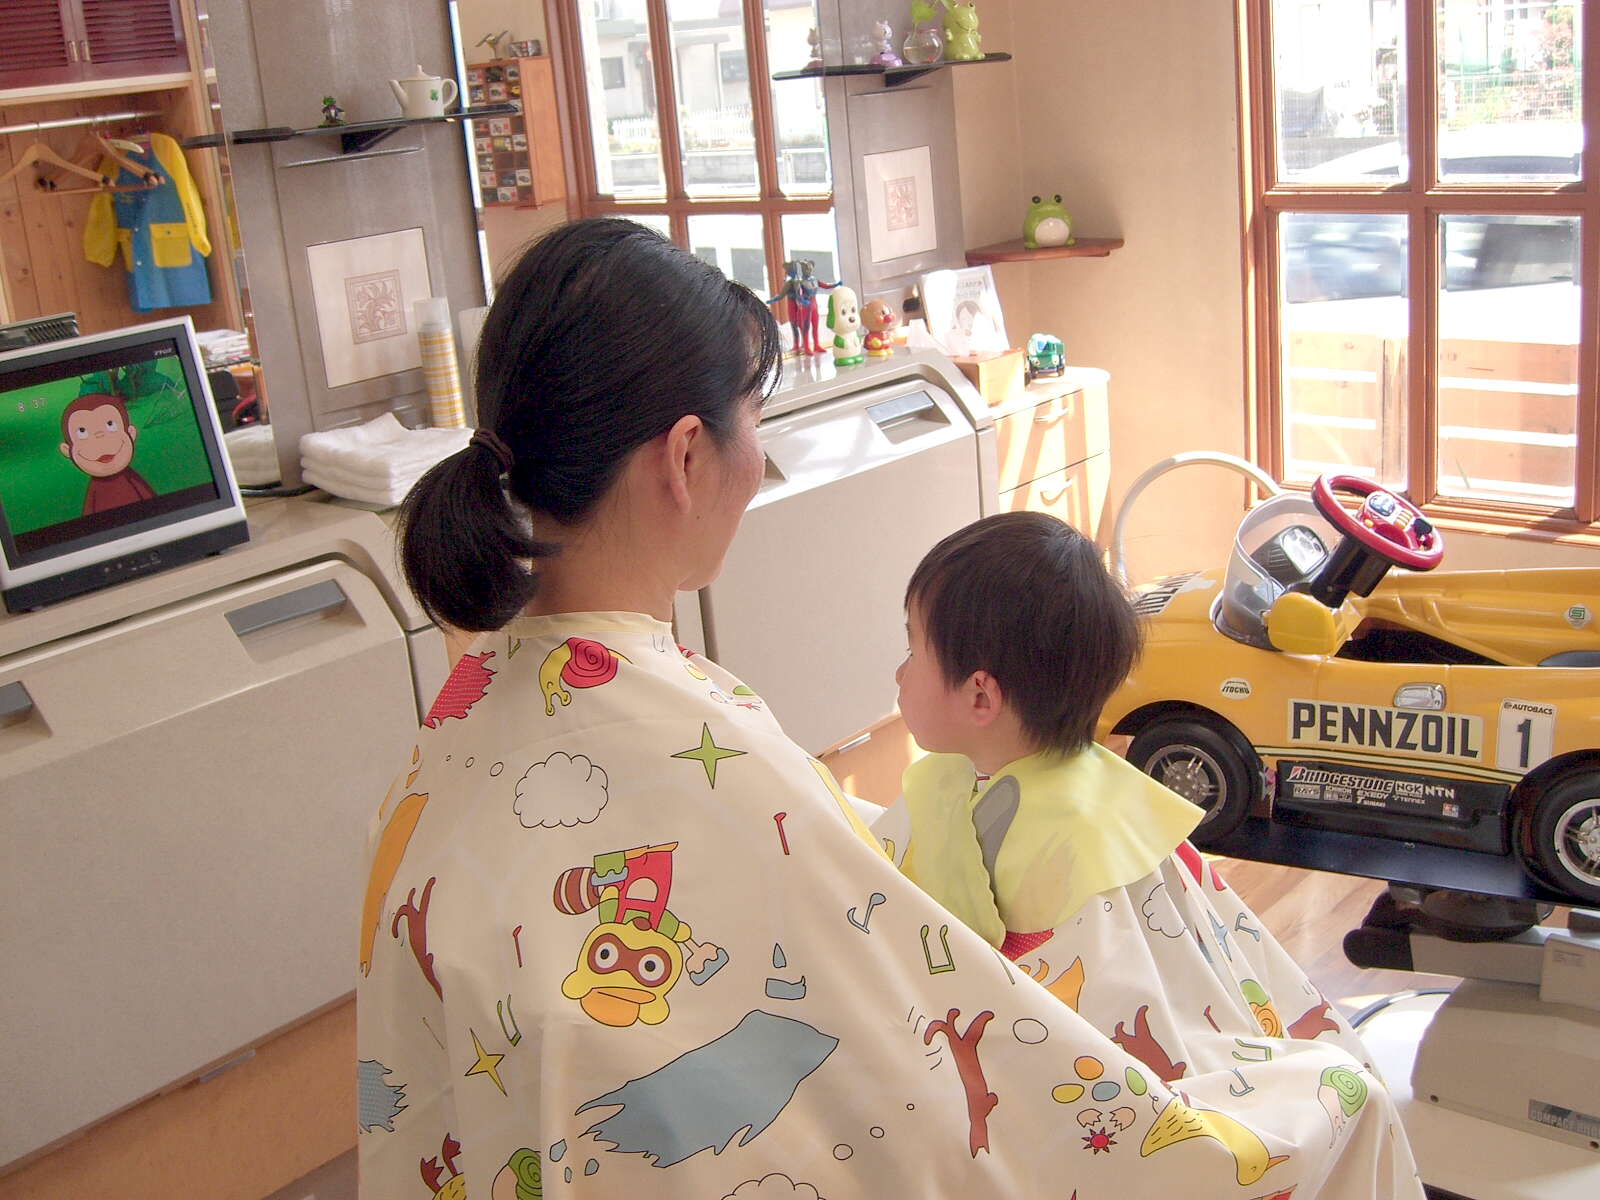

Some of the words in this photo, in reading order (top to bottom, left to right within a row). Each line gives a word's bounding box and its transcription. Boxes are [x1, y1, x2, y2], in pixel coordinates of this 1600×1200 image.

[1221, 685, 1250, 694] ITOCHU
[1511, 703, 1553, 715] AUTOBACS
[1292, 702, 1479, 759] PENNZOIL
[1517, 718, 1532, 769] 1
[1286, 766, 1395, 794] BRIDGESTONE
[1294, 787, 1320, 796] RAYS
[1396, 782, 1422, 794] NGK
[1425, 785, 1455, 799] NTN
[1356, 790, 1390, 799] EXEDY
